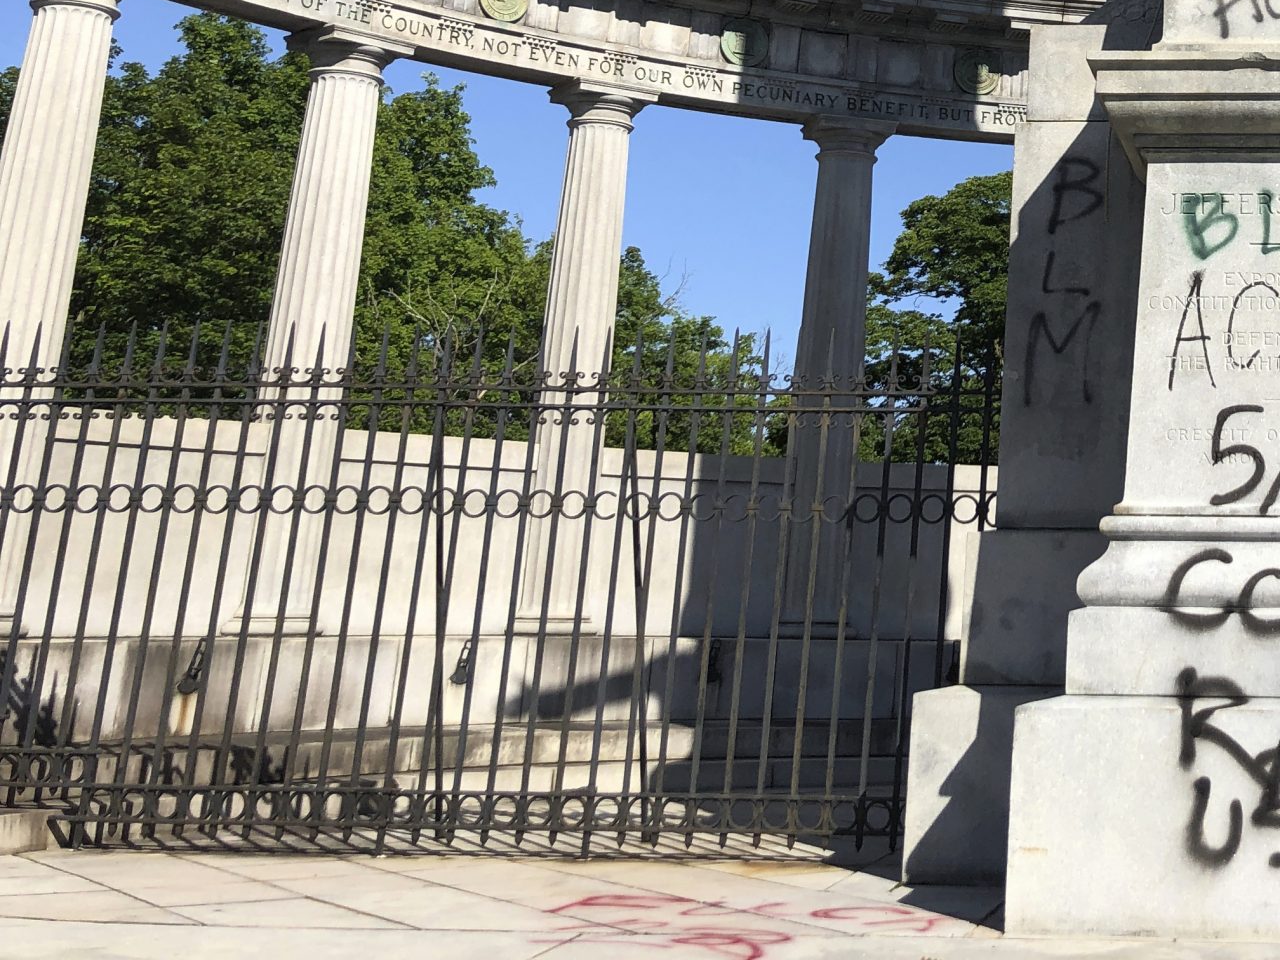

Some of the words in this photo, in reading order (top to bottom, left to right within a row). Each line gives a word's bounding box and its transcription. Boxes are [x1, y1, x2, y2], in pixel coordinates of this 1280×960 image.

[336, 2, 372, 25] THE
[381, 13, 474, 50] COUNTRY,
[483, 38, 522, 57] NOT
[530, 47, 579, 68] EVEN
[588, 58, 624, 77] FOR
[635, 67, 672, 85] OUR
[683, 74, 724, 93] OWN
[732, 82, 840, 109] PECUNIARY
[939, 109, 973, 122] BUT
[1166, 355, 1206, 371] THE
